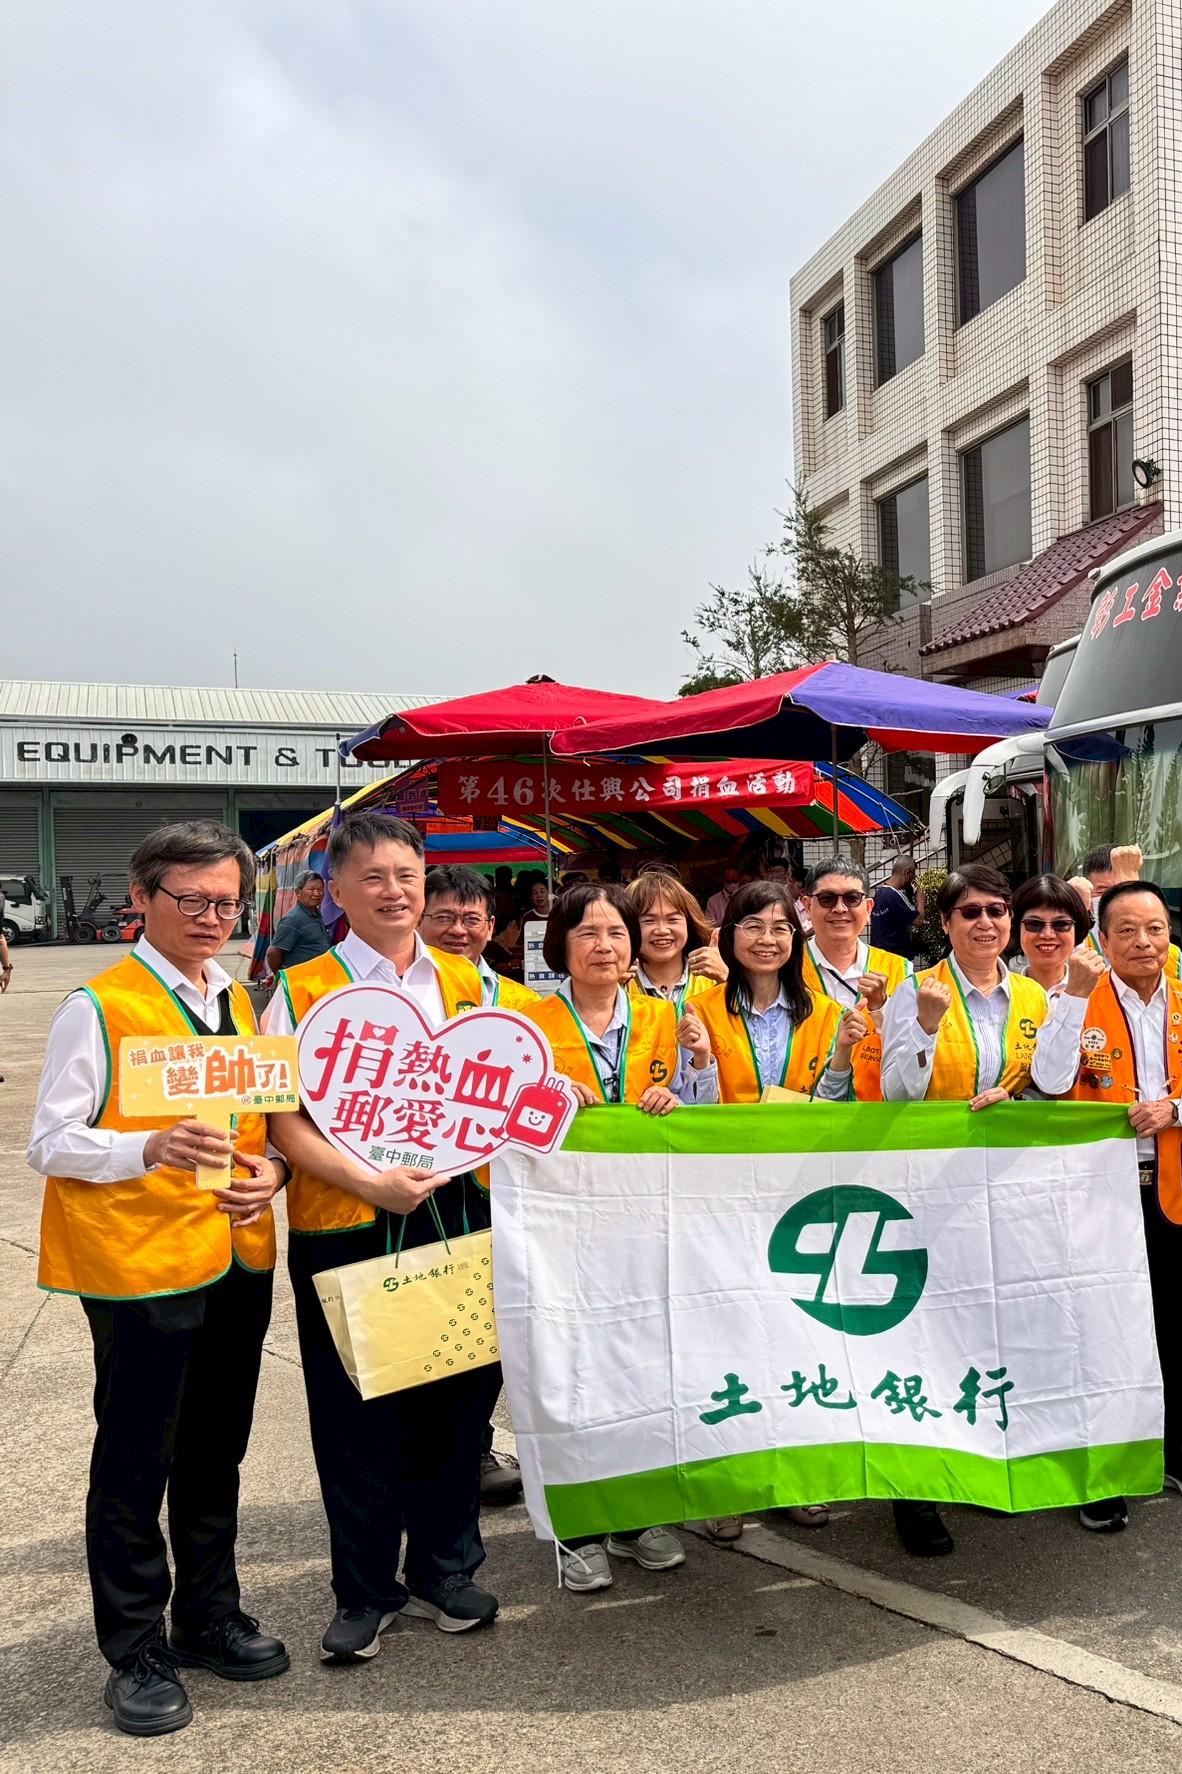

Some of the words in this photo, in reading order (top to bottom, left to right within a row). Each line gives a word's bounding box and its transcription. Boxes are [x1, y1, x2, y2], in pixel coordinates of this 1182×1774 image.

[16, 740, 258, 767] EQUIPMENT
[274, 747, 300, 767] &
[458, 769, 796, 806] 第46次仕興公司捐血活動
[130, 1043, 205, 1066] 捐血讓我
[308, 1017, 515, 1113] 捐熱血
[166, 1049, 288, 1096] 變帥了!
[253, 1094, 296, 1104] 臺中郵局
[329, 1089, 505, 1153] 郵愛心
[368, 1145, 434, 1170] 臺中郵局
[402, 1264, 454, 1285] 土地銀行
[698, 1363, 1015, 1432] 土地銀行
